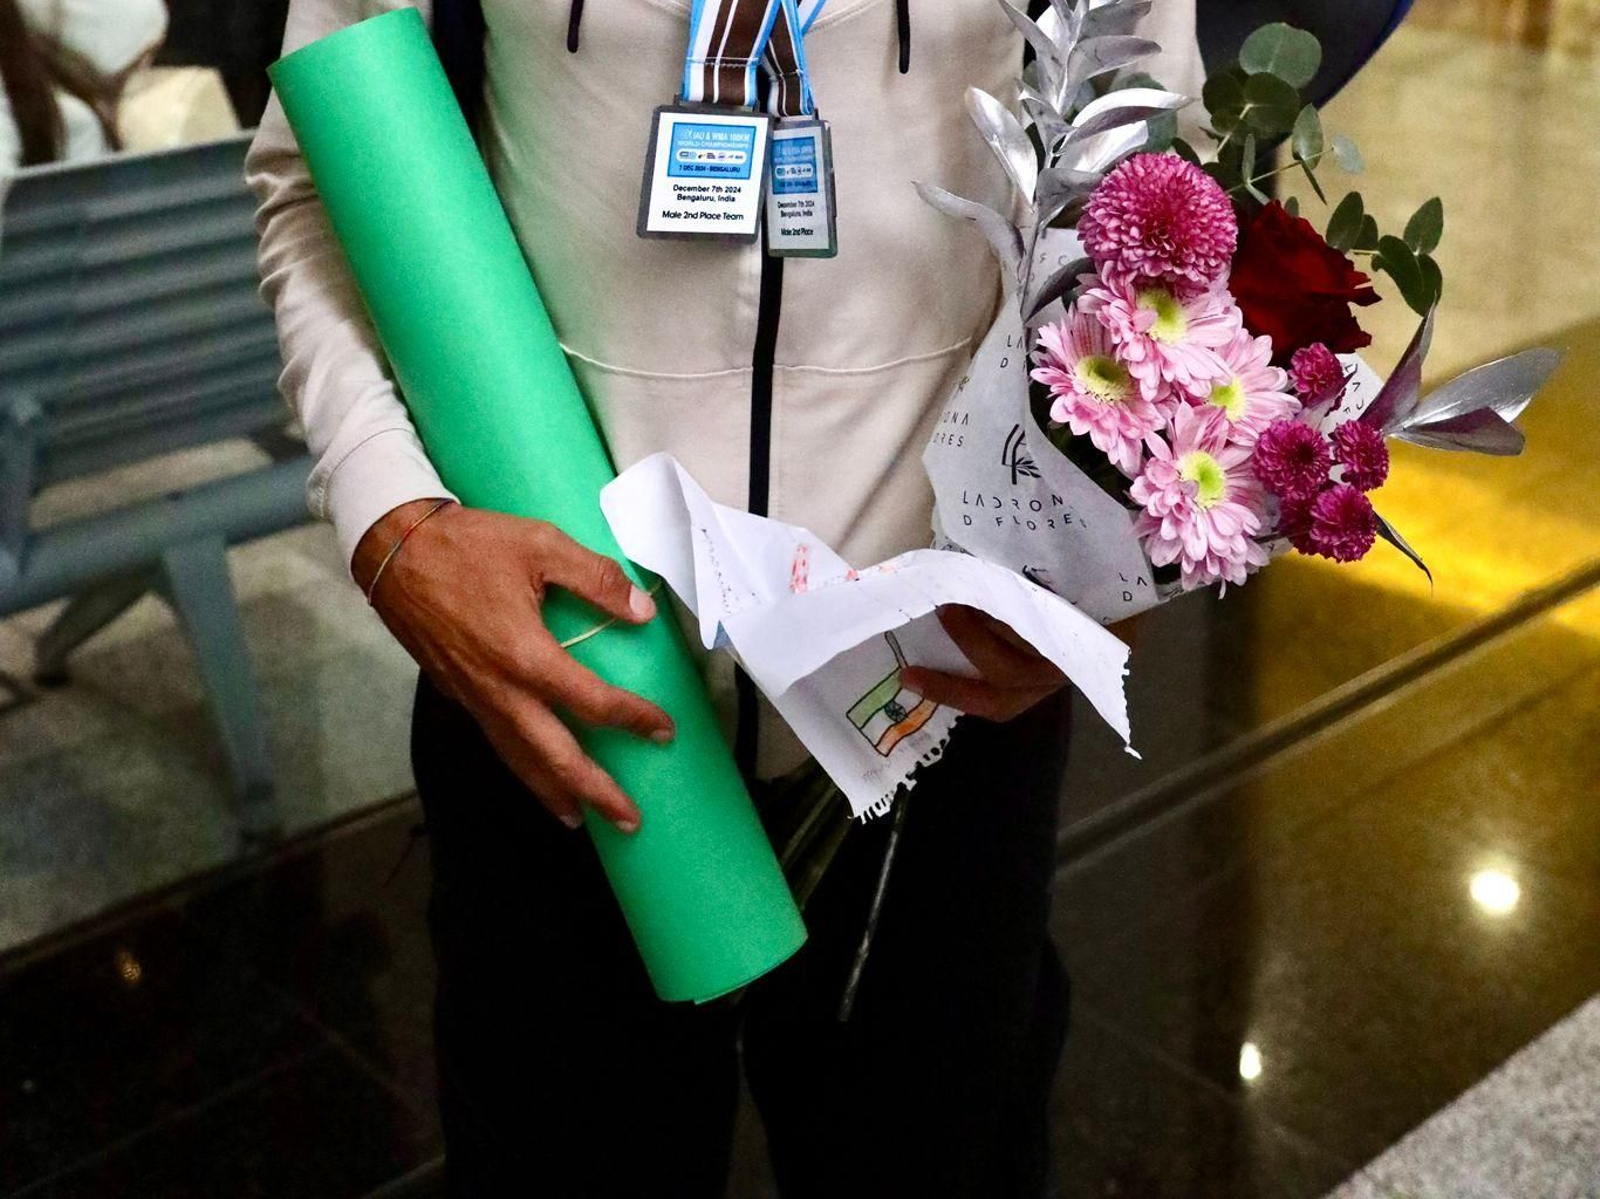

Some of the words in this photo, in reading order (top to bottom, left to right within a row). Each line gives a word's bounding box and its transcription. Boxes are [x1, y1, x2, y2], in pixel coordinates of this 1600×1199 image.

[673, 184, 709, 193] December
[711, 185, 723, 193] 7th
[725, 186, 742, 194] 2024
[677, 194, 716, 203] Bengaluru,
[718, 195, 736, 203] India
[662, 211, 682, 219] Male
[683, 211, 698, 219] 2nd
[699, 211, 721, 220] Place
[723, 212, 744, 220] Team
